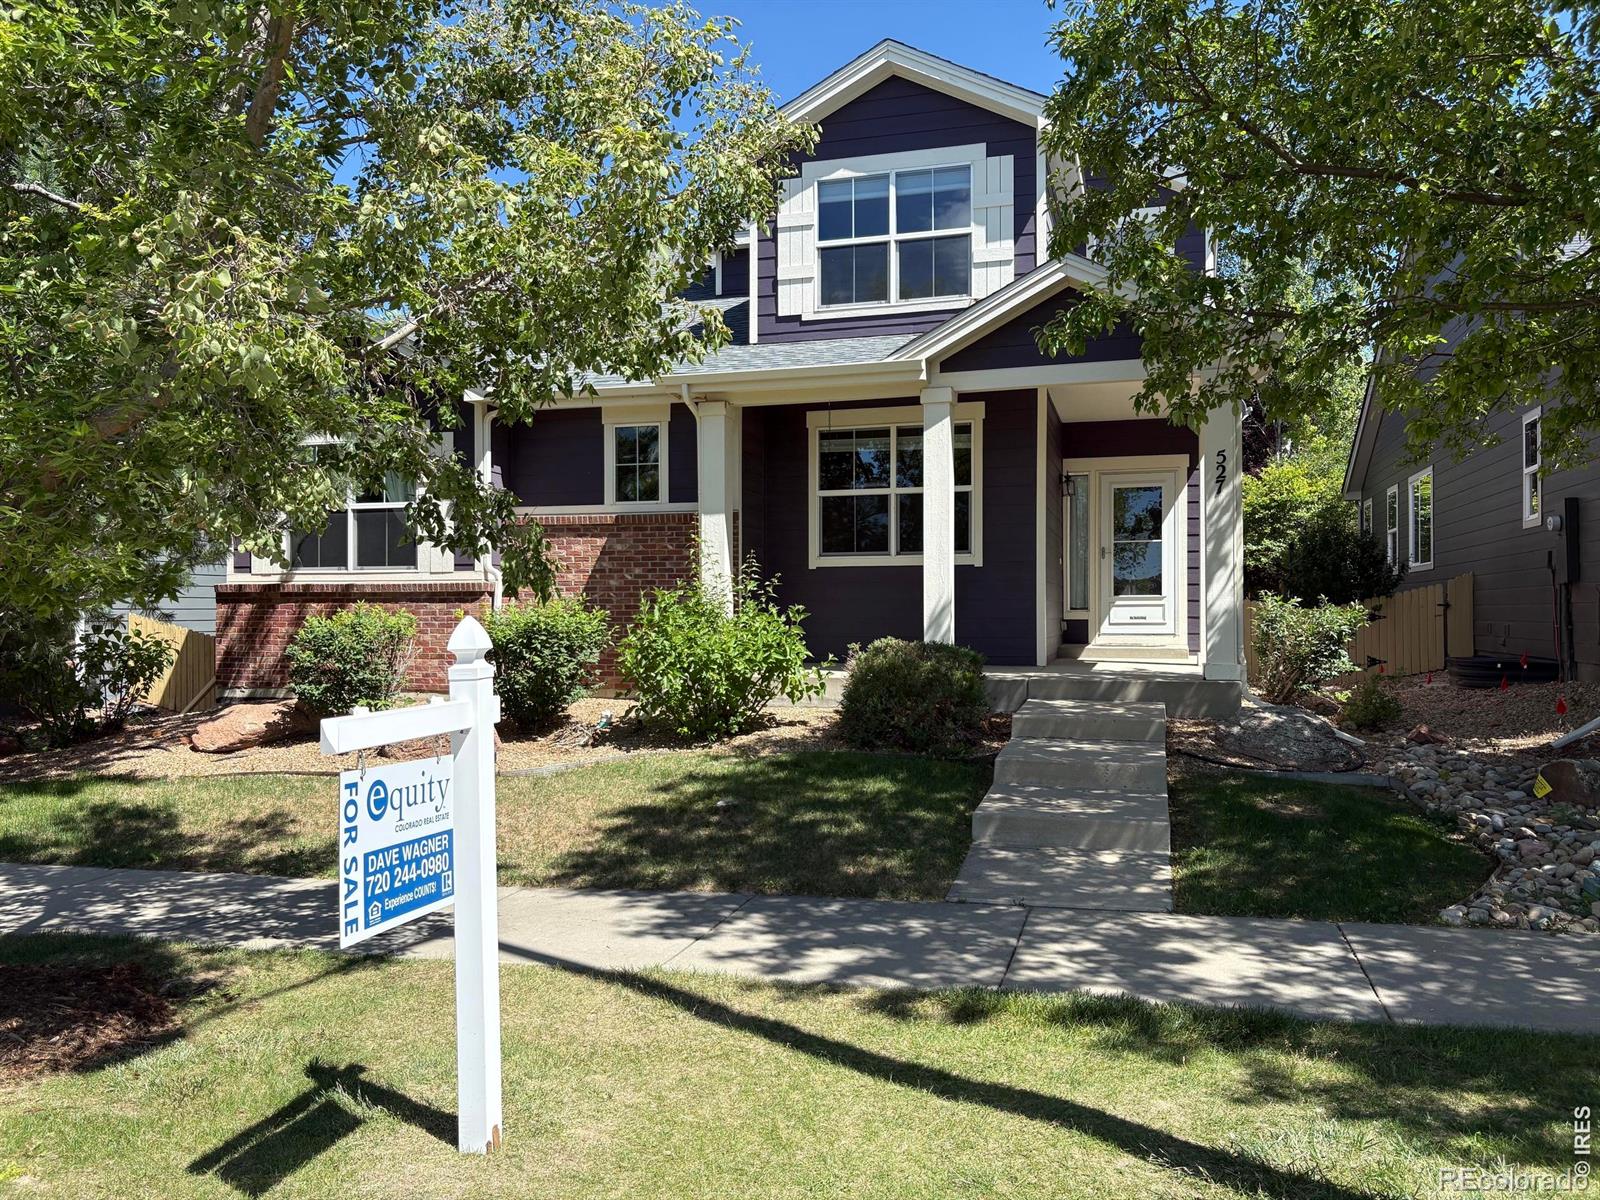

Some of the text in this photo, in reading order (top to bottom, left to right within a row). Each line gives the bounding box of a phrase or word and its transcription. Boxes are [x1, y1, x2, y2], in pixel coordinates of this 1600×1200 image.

[1215, 448, 1227, 495] 527
[366, 770, 450, 822] equity
[394, 811, 450, 833] COLORADO REAL ESTATE
[343, 781, 359, 938] FOR SALE
[366, 852, 450, 898] 720 244-0980
[368, 834, 449, 873] DAVE WAGNER
[384, 880, 437, 911] Experience COUNTS!
